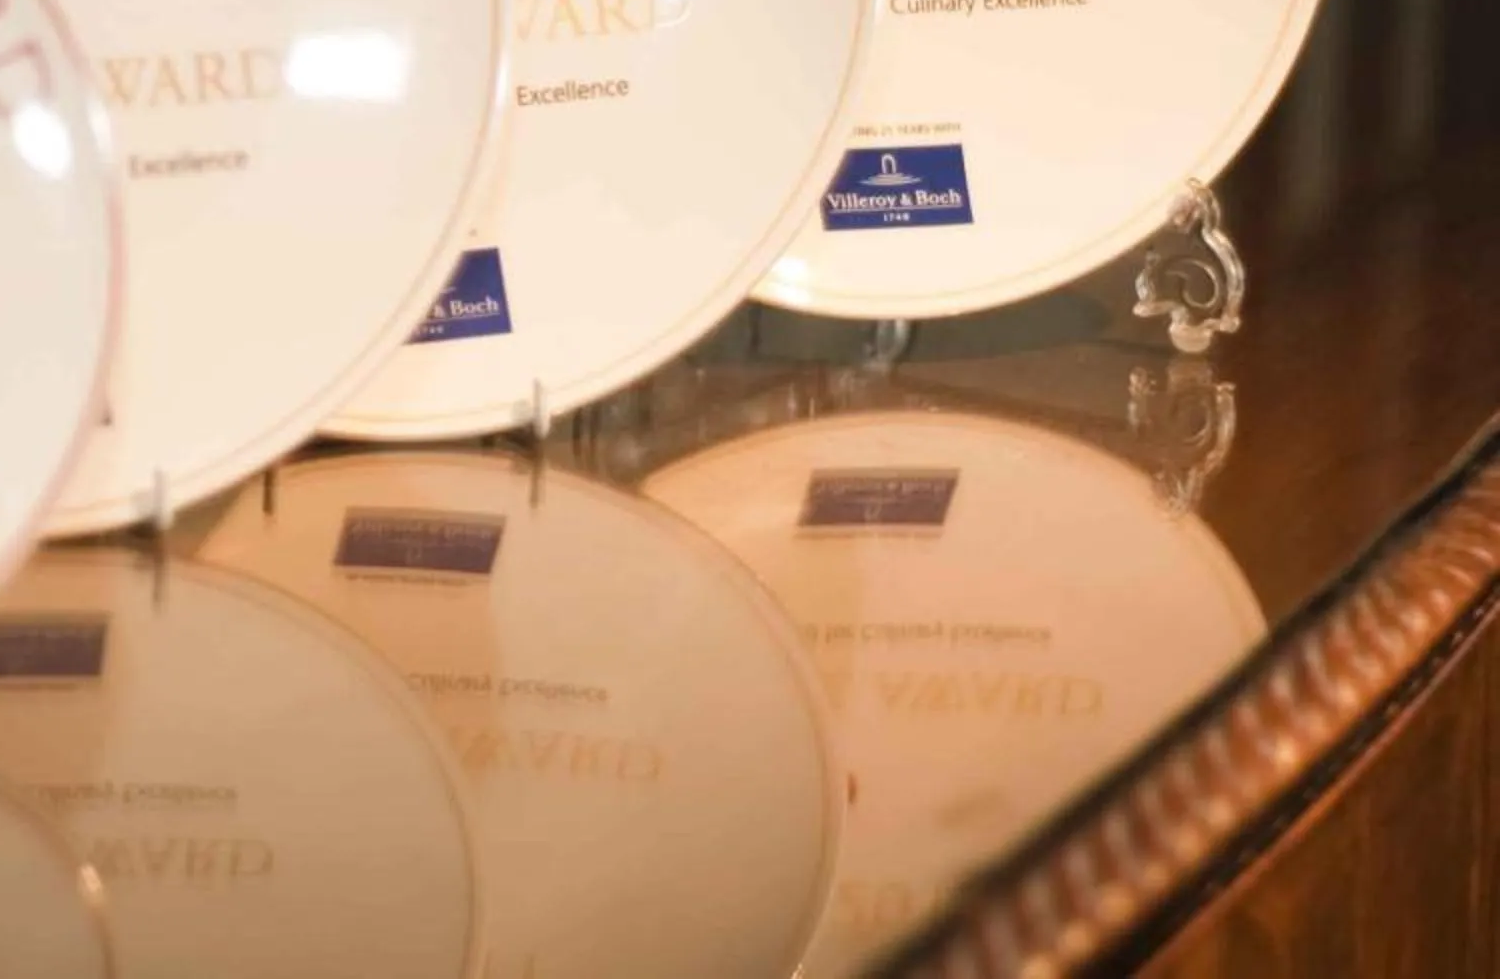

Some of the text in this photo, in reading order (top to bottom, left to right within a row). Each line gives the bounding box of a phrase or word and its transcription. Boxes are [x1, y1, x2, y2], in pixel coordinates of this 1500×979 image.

[514, 77, 631, 108] Excellence
[127, 148, 251, 181] Excellence
[826, 188, 961, 212] Villeroy & Boch
[449, 294, 499, 318] Boch
